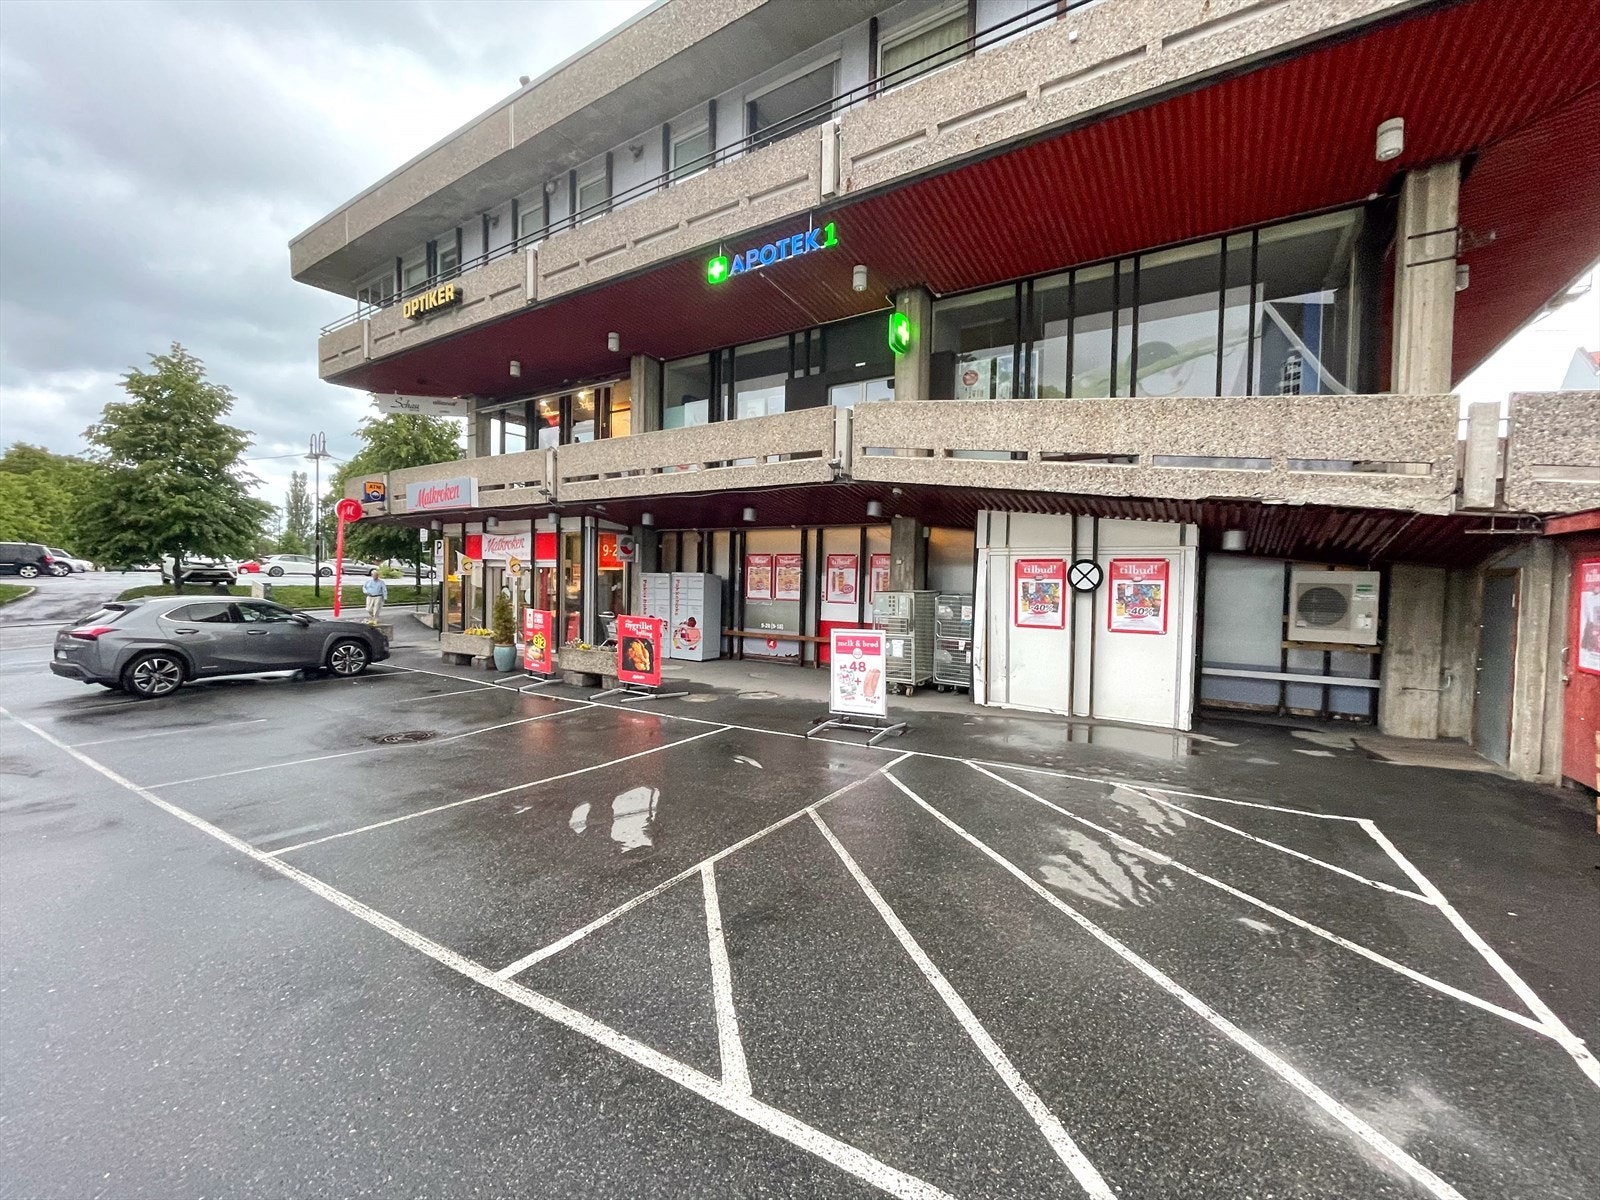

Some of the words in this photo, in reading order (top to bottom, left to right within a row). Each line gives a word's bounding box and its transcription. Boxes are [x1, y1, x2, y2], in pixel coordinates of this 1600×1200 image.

[730, 228, 820, 275] APOTEK
[824, 222, 838, 247] 1
[403, 283, 455, 319] OPTIKER
[416, 483, 459, 508] Matkroken
[437, 541, 442, 555] P
[1023, 565, 1057, 574] tilbud!
[1120, 565, 1158, 575] tilbud!
[862, 640, 879, 648] brød
[849, 661, 866, 672] 48
